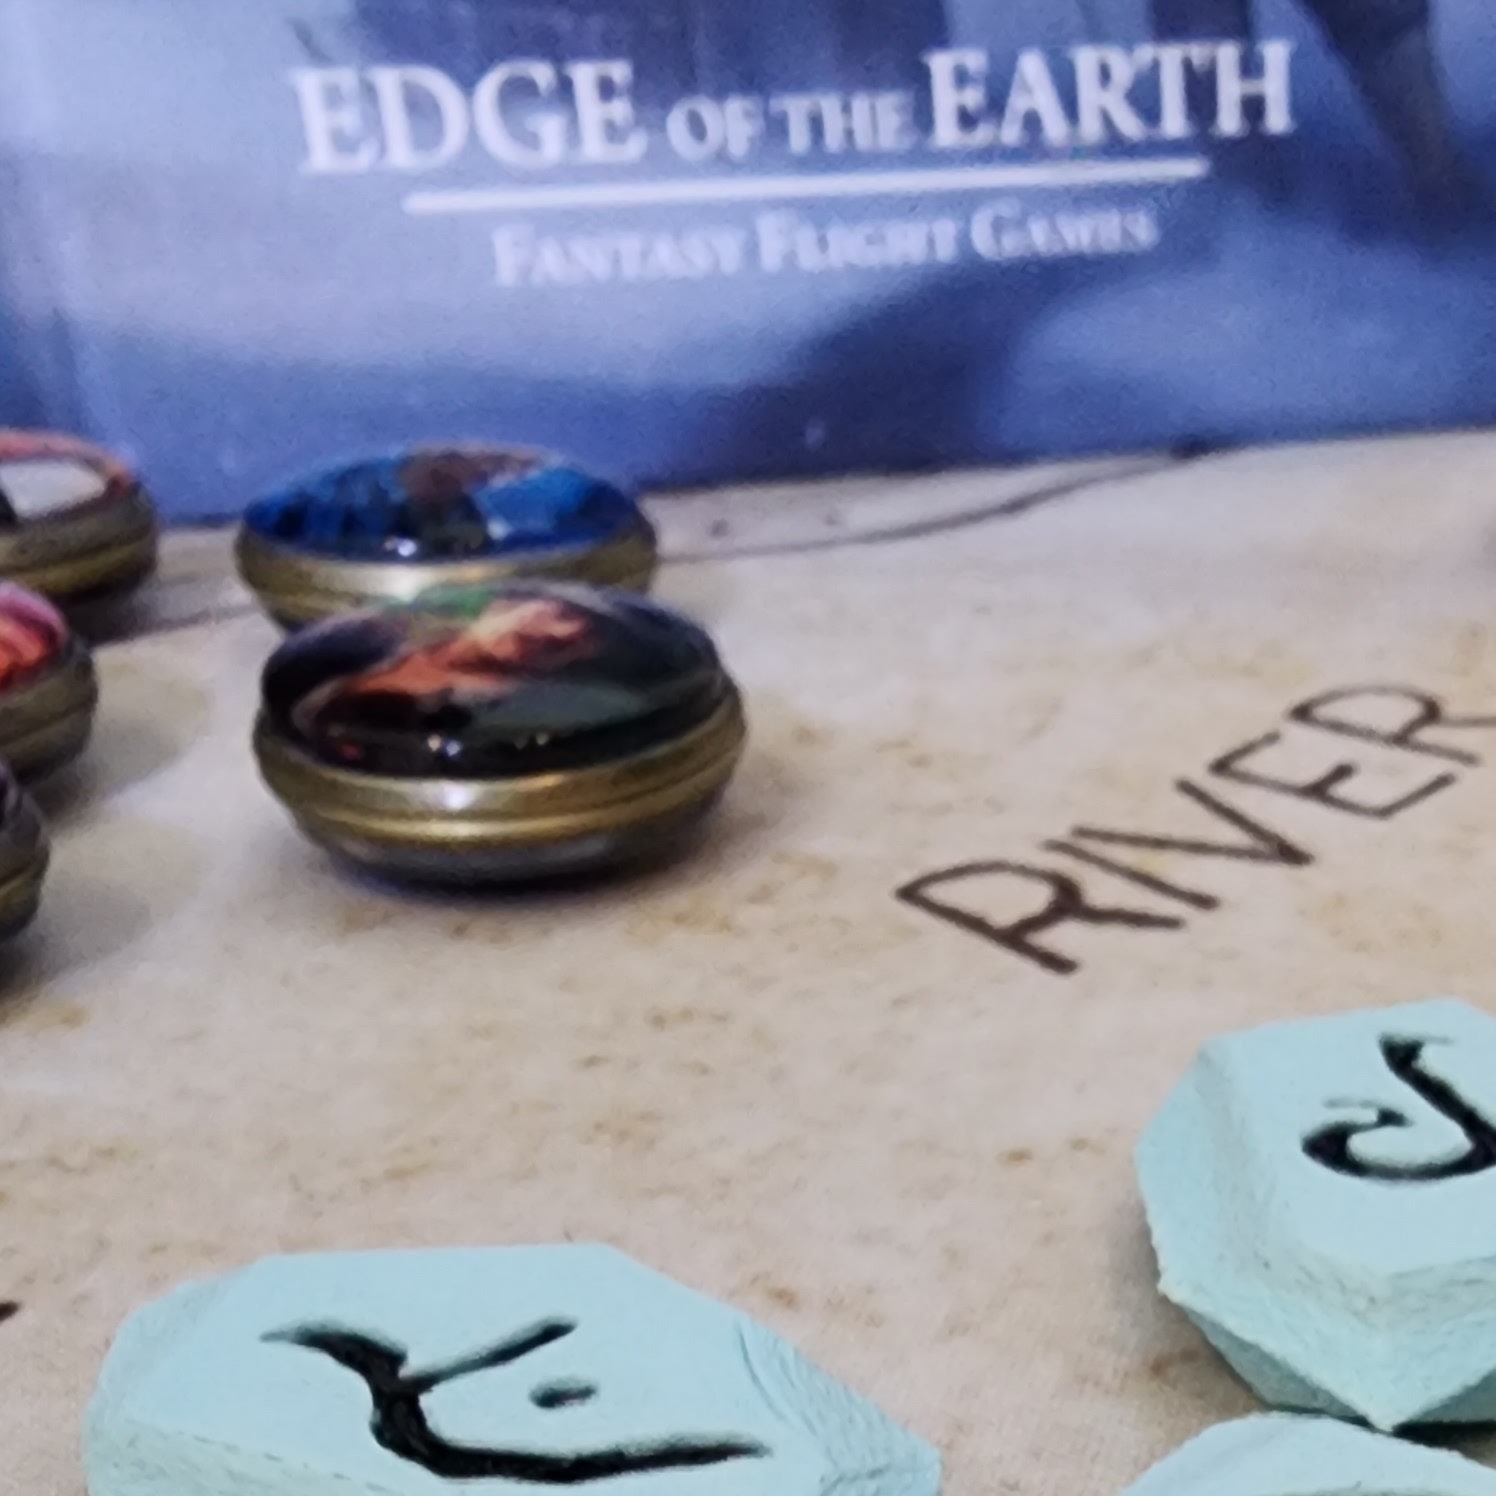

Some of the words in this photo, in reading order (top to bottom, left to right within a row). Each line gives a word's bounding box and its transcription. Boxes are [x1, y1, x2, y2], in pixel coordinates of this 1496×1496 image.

[295, 58, 646, 174] EDGE
[665, 94, 766, 161] OF
[771, 88, 911, 154] THE
[923, 40, 1298, 149] EARTH
